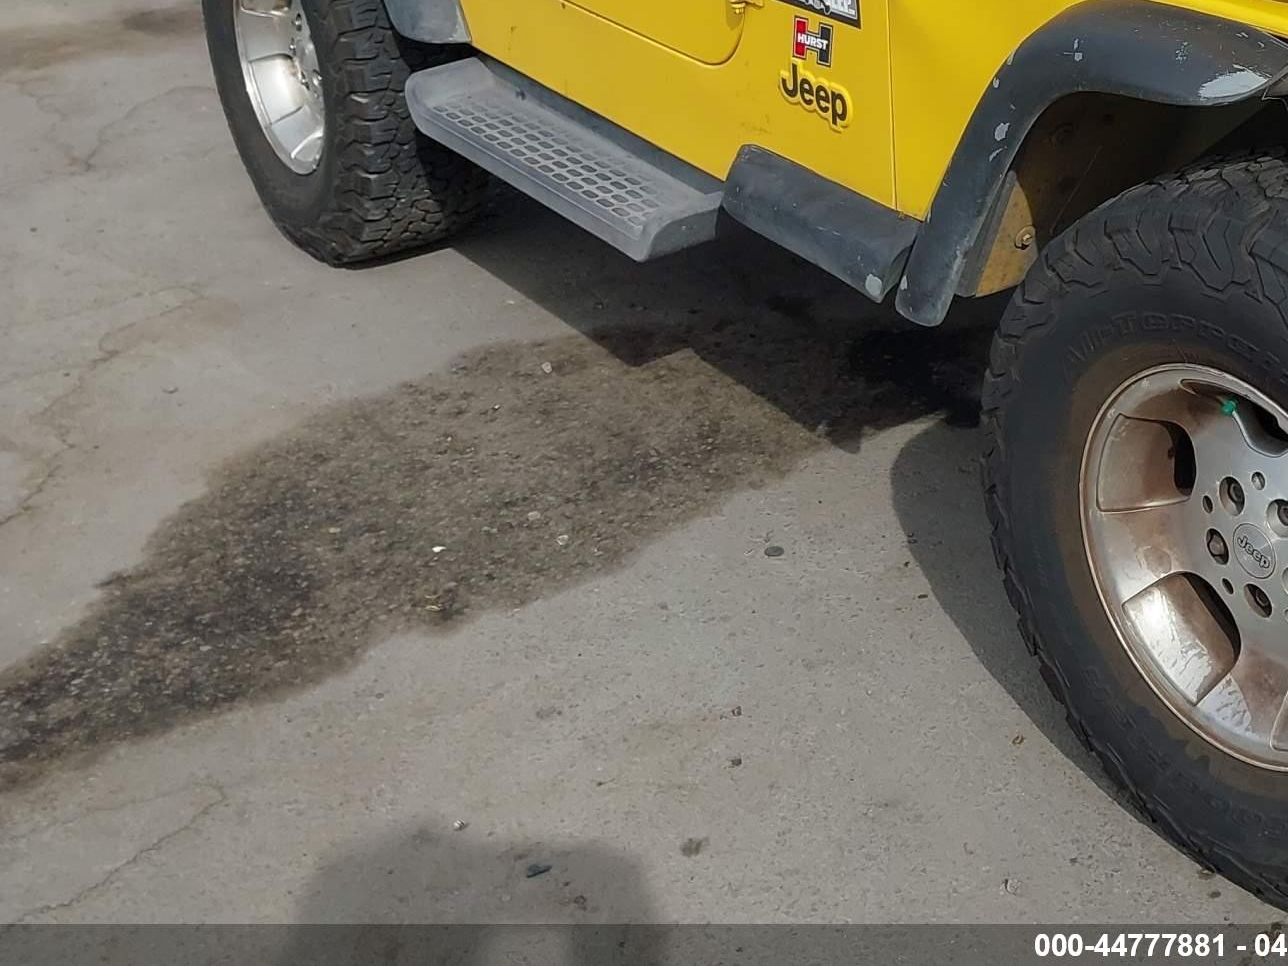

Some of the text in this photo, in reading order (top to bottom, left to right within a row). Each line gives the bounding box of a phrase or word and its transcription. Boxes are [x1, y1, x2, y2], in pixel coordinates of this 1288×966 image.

[797, 32, 828, 51] HURST
[780, 63, 848, 126] Jeep
[1237, 536, 1270, 569] Jeep
